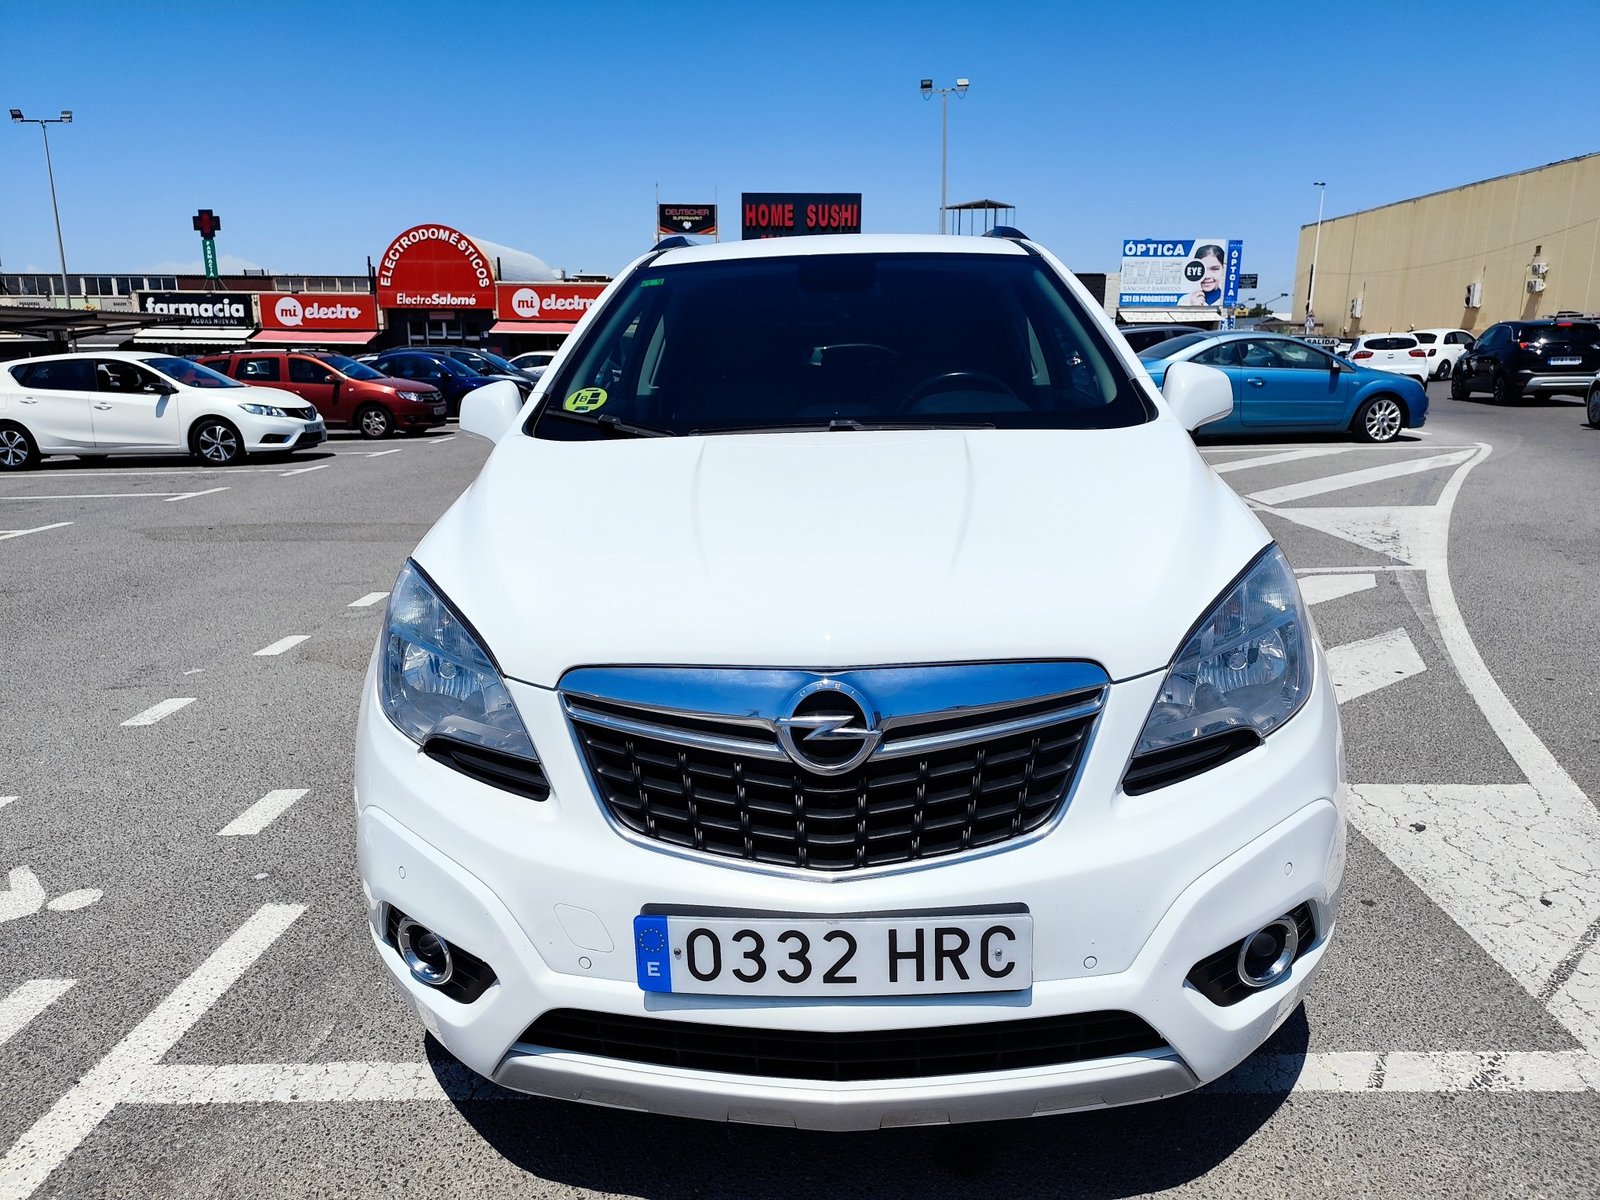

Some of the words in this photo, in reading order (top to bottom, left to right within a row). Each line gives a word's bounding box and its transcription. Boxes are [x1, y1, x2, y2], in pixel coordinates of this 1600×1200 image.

[665, 208, 710, 216] DEUTSCHER
[745, 204, 794, 226] HOME
[806, 204, 858, 227] SUSHI
[1124, 241, 1185, 256] ÓPTICA
[206, 240, 214, 277] FARMACIA
[380, 227, 490, 288] ELECTRODOMÉSTICOS
[1186, 266, 1202, 276] EYE
[145, 297, 245, 318] farmacia
[280, 304, 298, 318] mi
[304, 303, 361, 319] electro
[517, 297, 536, 309] mi
[686, 926, 858, 984] 0332
[888, 925, 1016, 983] HRC
[647, 961, 661, 977] E
